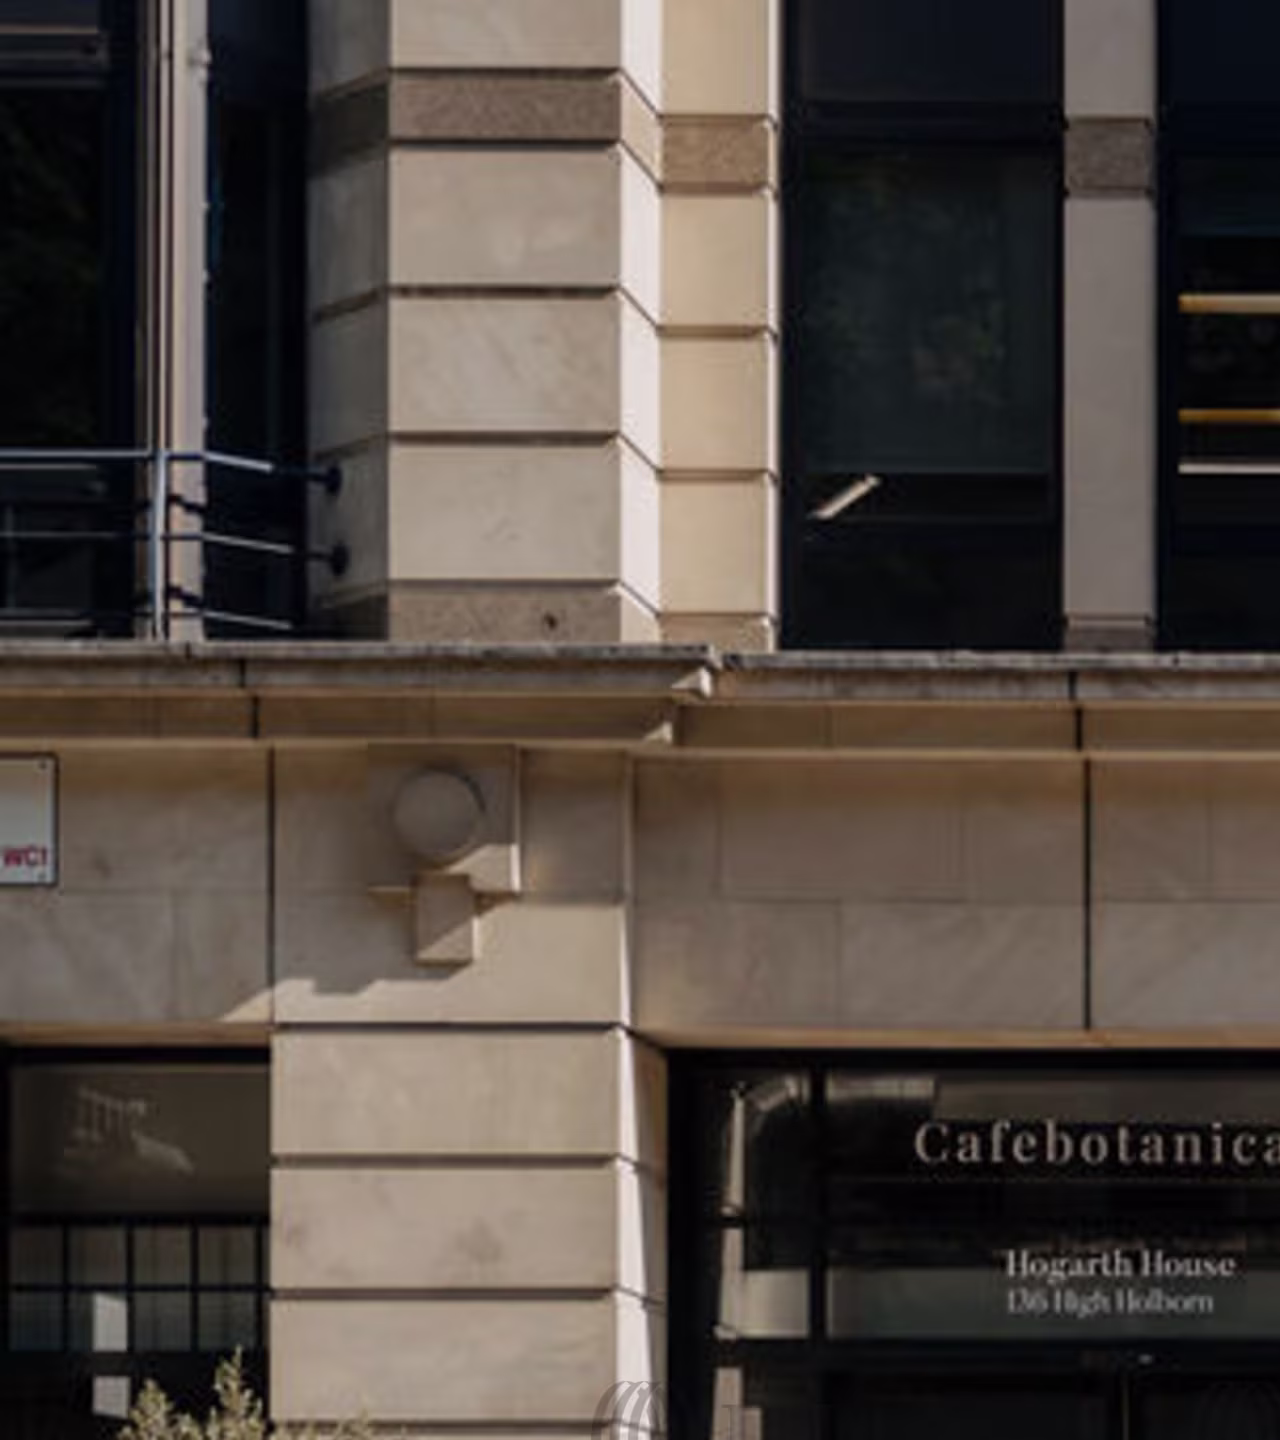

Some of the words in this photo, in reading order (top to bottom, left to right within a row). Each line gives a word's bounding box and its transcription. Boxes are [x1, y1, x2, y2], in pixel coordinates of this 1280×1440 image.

[1006, 1248, 1132, 1285] Hogarth
[1142, 1248, 1237, 1277] House
[1054, 1289, 1111, 1317] High
[1116, 1289, 1215, 1313] Holborn
